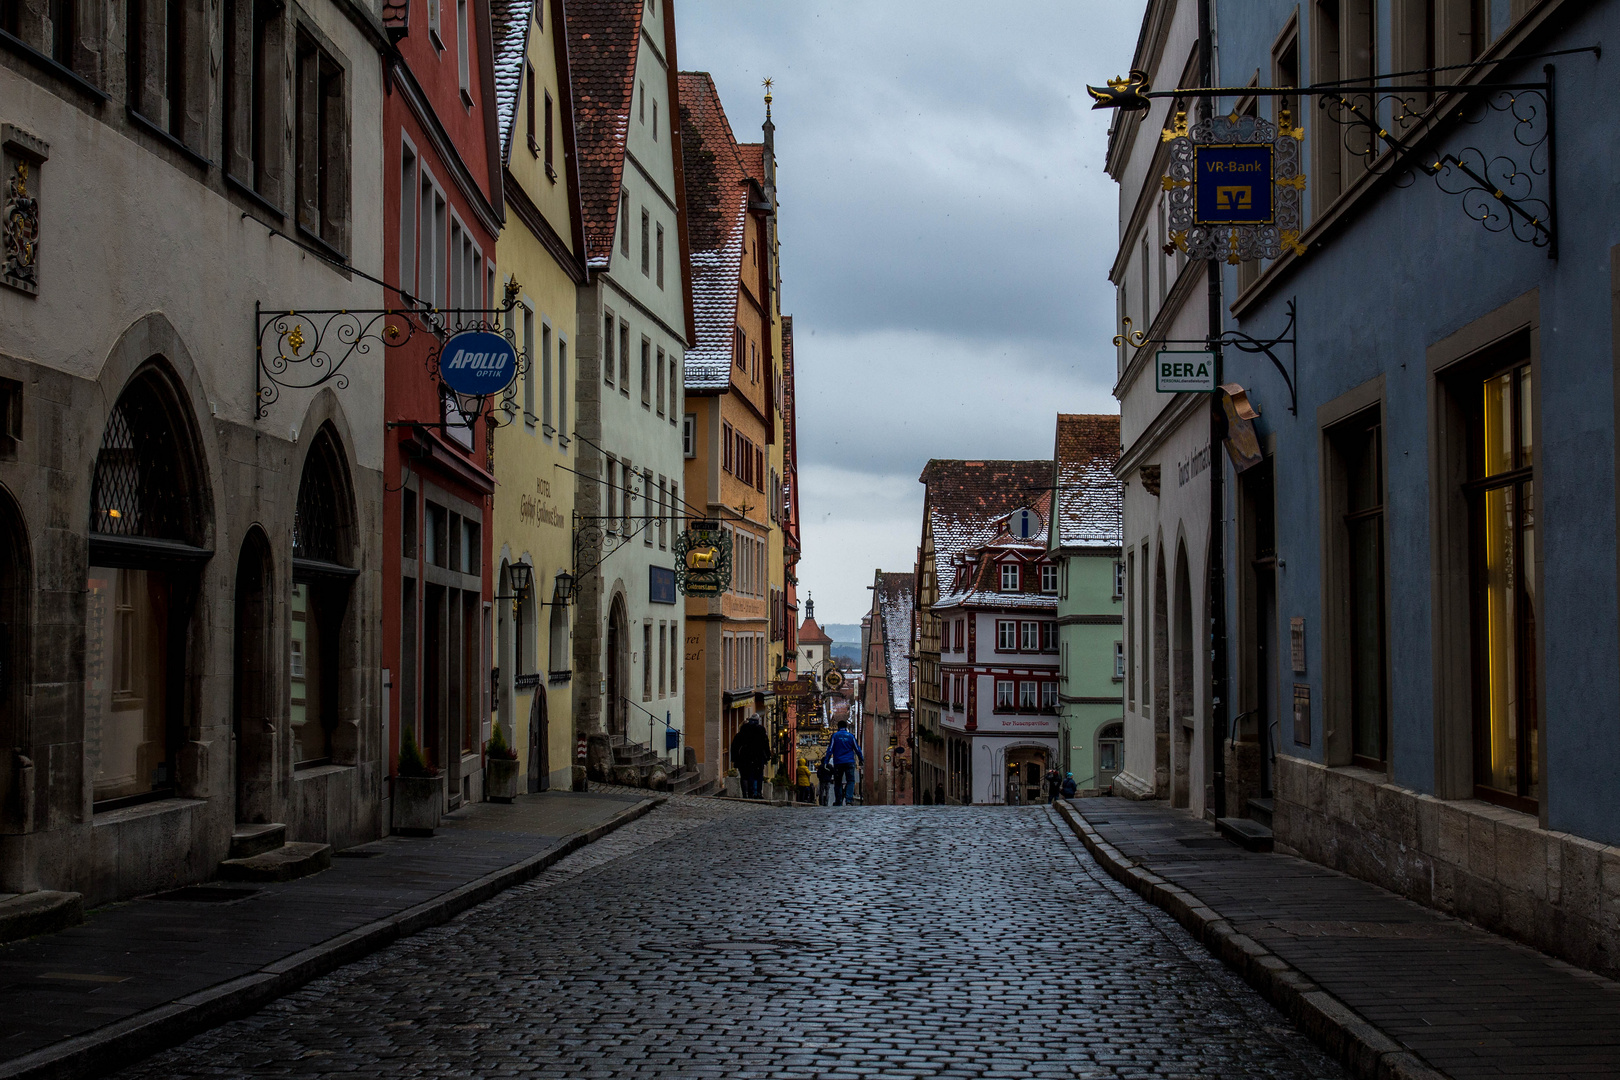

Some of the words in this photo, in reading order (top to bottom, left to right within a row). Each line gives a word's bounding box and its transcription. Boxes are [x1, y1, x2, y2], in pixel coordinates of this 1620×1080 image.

[1206, 160, 1262, 172] VR-Bank
[448, 349, 508, 369] APOLLO
[536, 477, 551, 498] HOTEL
[685, 634, 700, 644] rei
